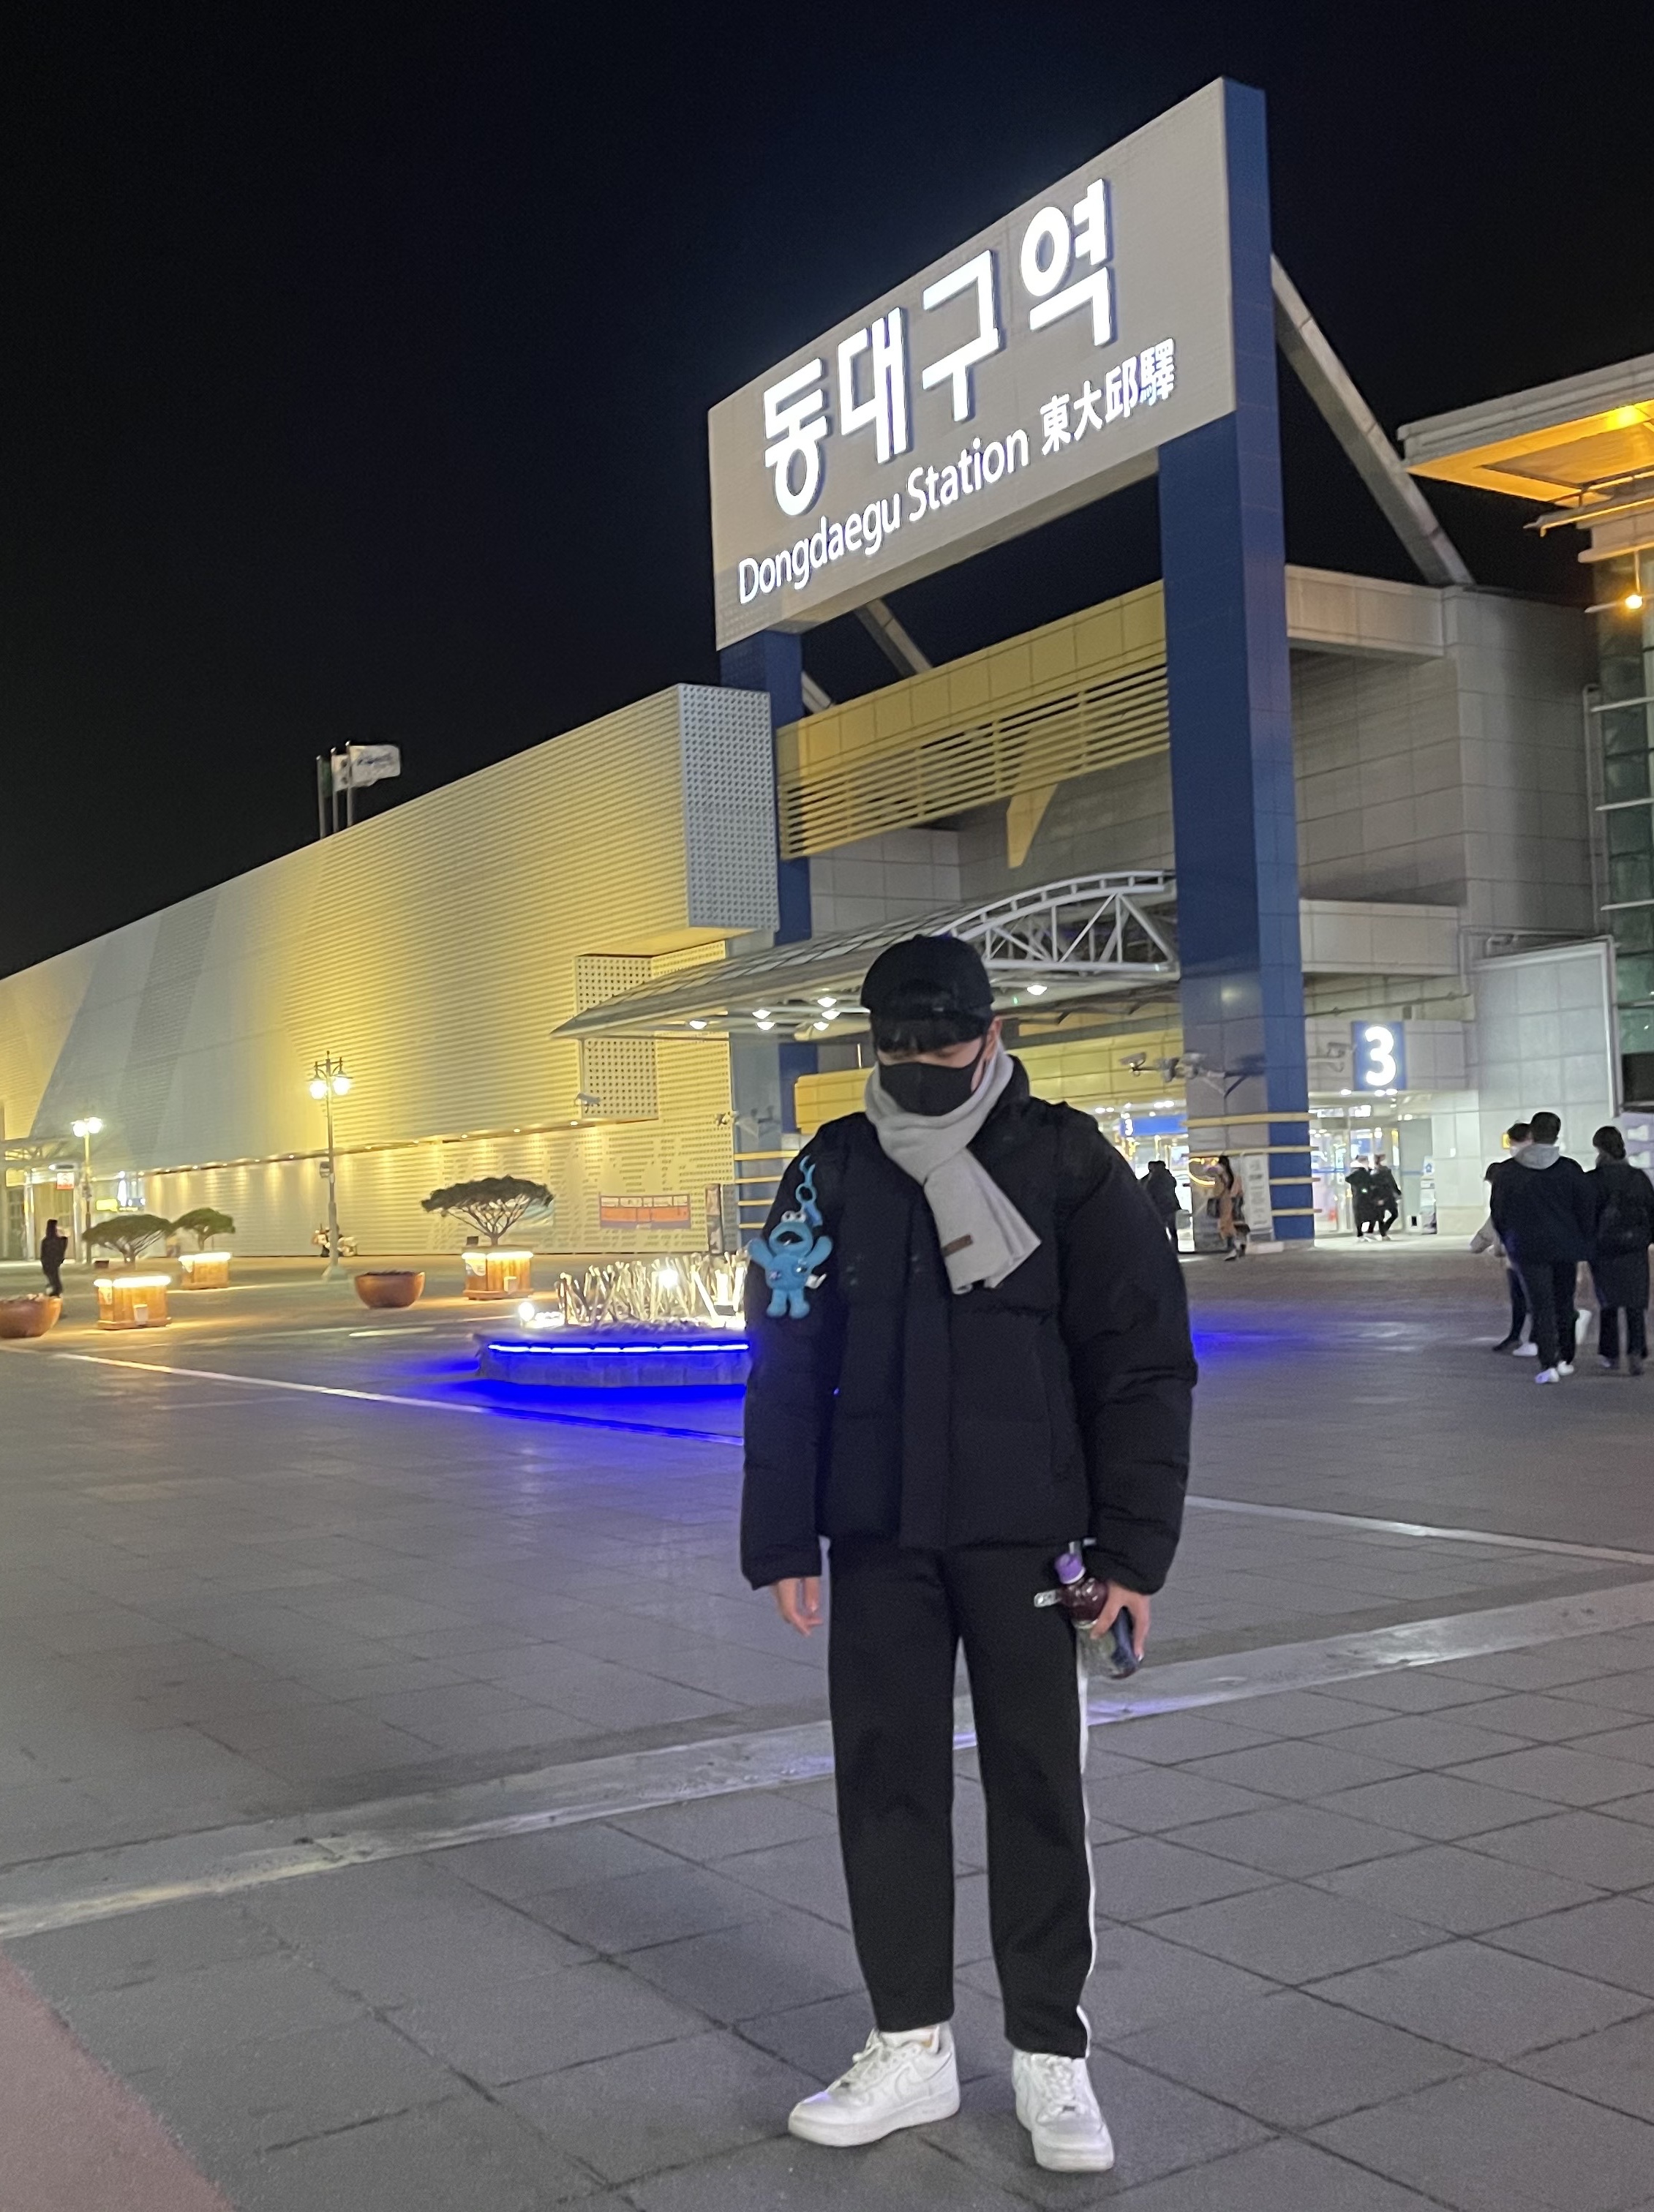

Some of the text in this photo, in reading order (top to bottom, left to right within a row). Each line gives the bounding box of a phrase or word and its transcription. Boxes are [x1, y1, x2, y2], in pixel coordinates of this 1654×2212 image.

[738, 337, 1176, 605] Dongdaegu Station 東大邱驛
[763, 178, 1110, 516] 동대구역
[1364, 1025, 1397, 1086] 3
